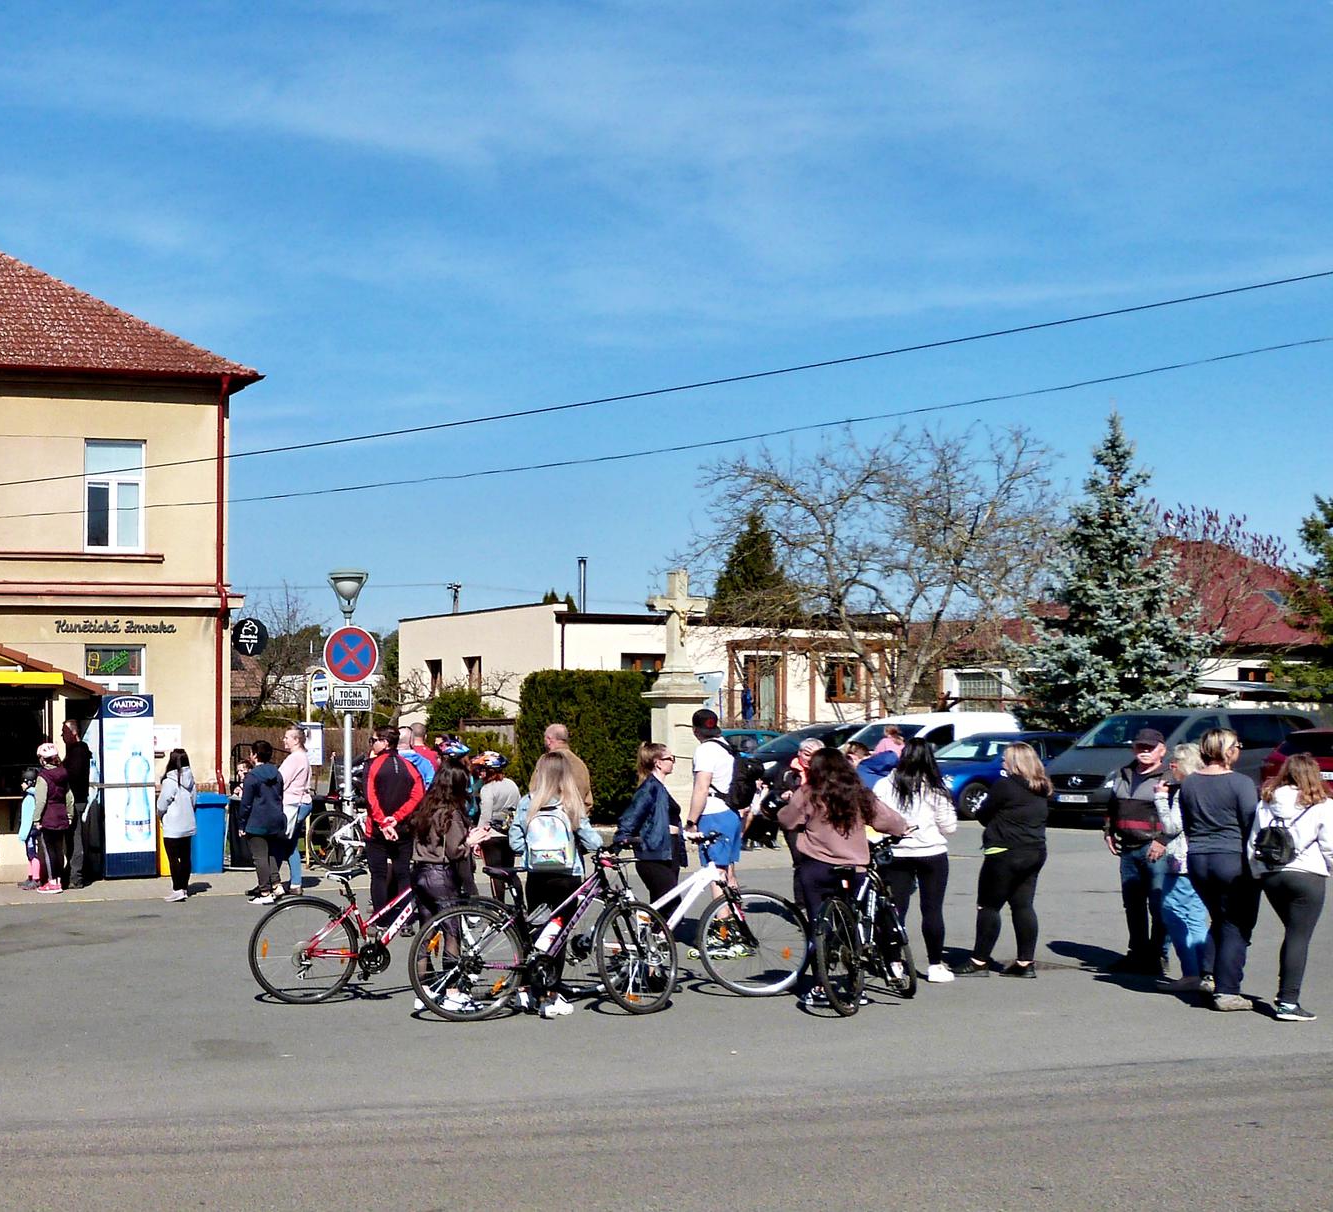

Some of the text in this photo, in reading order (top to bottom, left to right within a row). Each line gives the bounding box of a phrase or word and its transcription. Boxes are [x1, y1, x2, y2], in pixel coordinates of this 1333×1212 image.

[54, 619, 177, 634] Kunětická Zmrzka
[340, 689, 362, 698] TOČNA
[112, 700, 144, 709] MATTONI
[334, 699, 369, 707] AUTOBUSU
